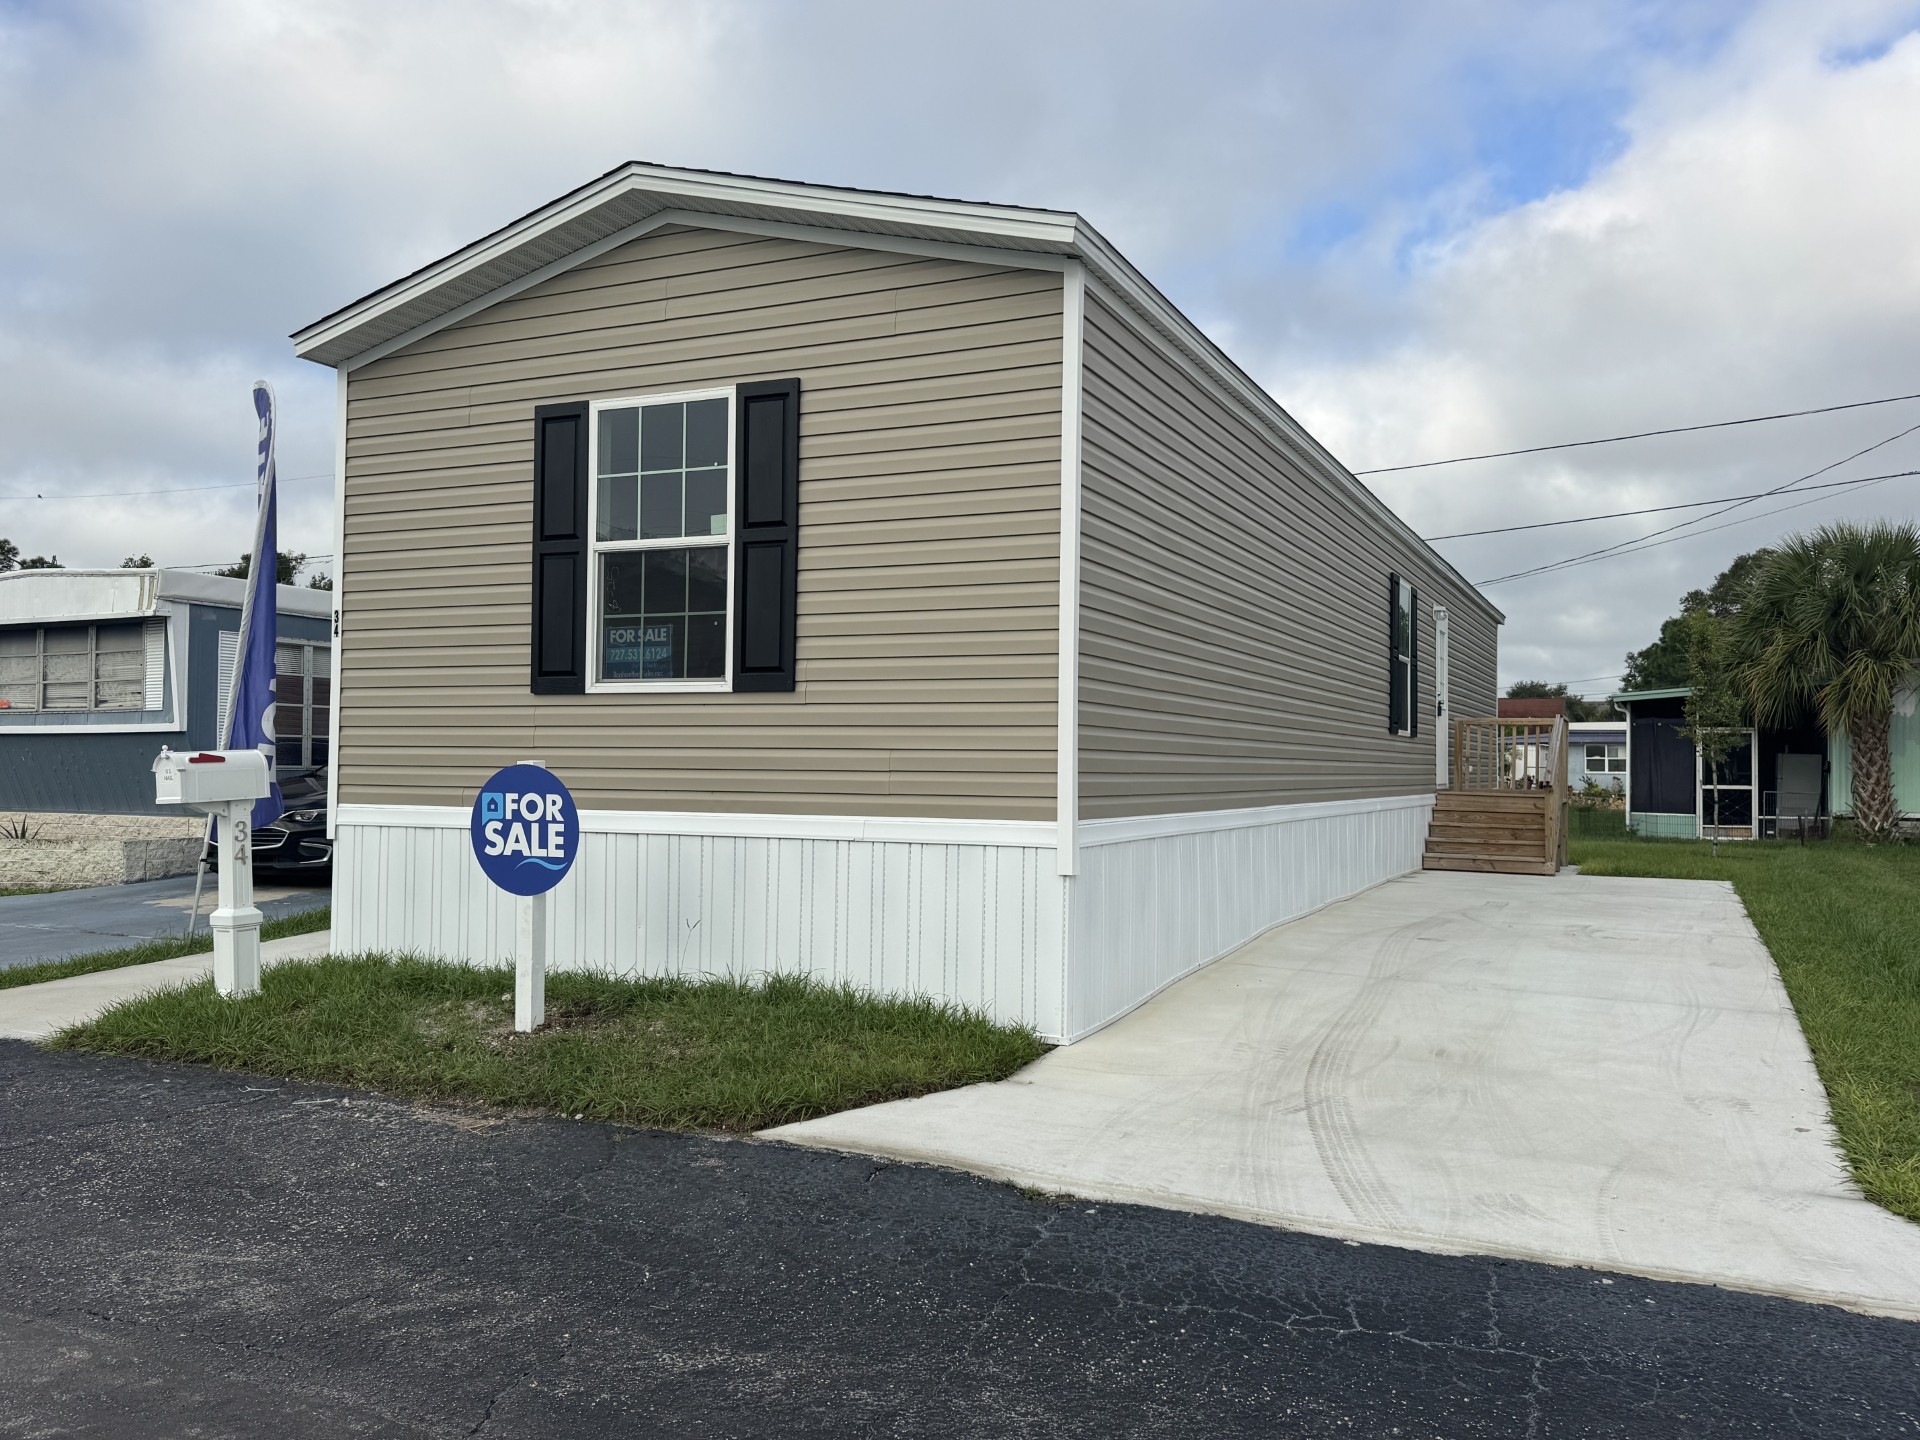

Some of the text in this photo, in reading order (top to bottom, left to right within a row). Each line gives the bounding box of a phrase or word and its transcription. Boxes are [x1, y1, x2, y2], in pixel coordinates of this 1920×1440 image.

[333, 609, 339, 638] 34
[609, 629, 636, 643] FOR
[505, 792, 565, 821] FOR
[233, 820, 249, 866] 34
[484, 820, 565, 858] SALE
